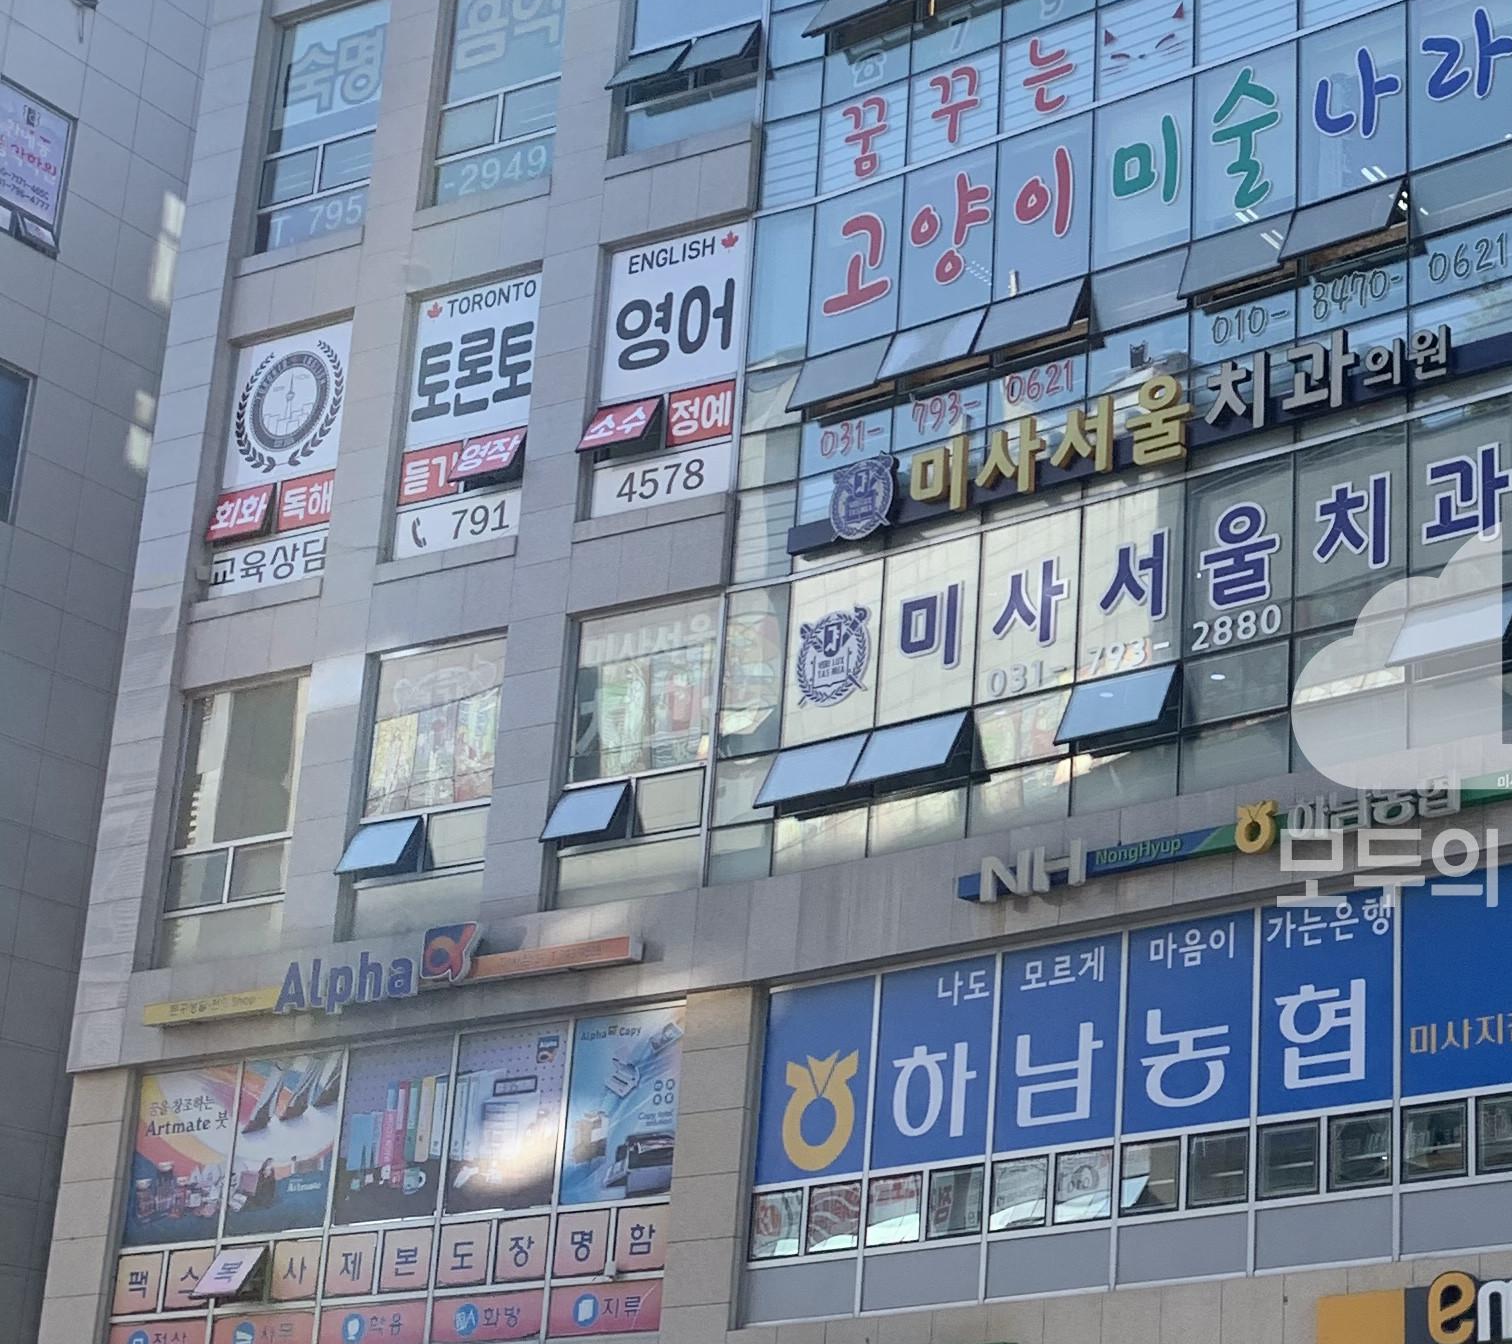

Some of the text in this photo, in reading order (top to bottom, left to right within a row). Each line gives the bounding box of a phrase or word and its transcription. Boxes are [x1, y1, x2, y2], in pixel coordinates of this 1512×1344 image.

[841, 37, 1076, 179] 꿈꾸는
[821, 146, 1073, 317] 고양이
[1110, 66, 1281, 212] 미술
[628, 235, 716, 276] ENGLISH
[447, 279, 538, 318] TORONTO
[615, 277, 737, 371] 영어
[410, 320, 536, 424] 토론토
[586, 404, 647, 444] 소수
[669, 385, 732, 438] 정예
[280, 478, 333, 521] 독해
[615, 458, 706, 505] 4578
[213, 491, 269, 532] 회화
[451, 499, 510, 541] 791
[211, 536, 327, 588] 교육상담
[979, 835, 1182, 902] NH NongHyup
[272, 950, 418, 1015] Alpha
[936, 968, 991, 1006] 나도
[1018, 945, 1107, 994] 모르게
[1148, 920, 1237, 970] 마음이
[891, 976, 1368, 1140] 하남농협
[145, 1117, 211, 1137] Artmate
[570, 1223, 656, 1264] 명함
[602, 1294, 643, 1318] 지류
